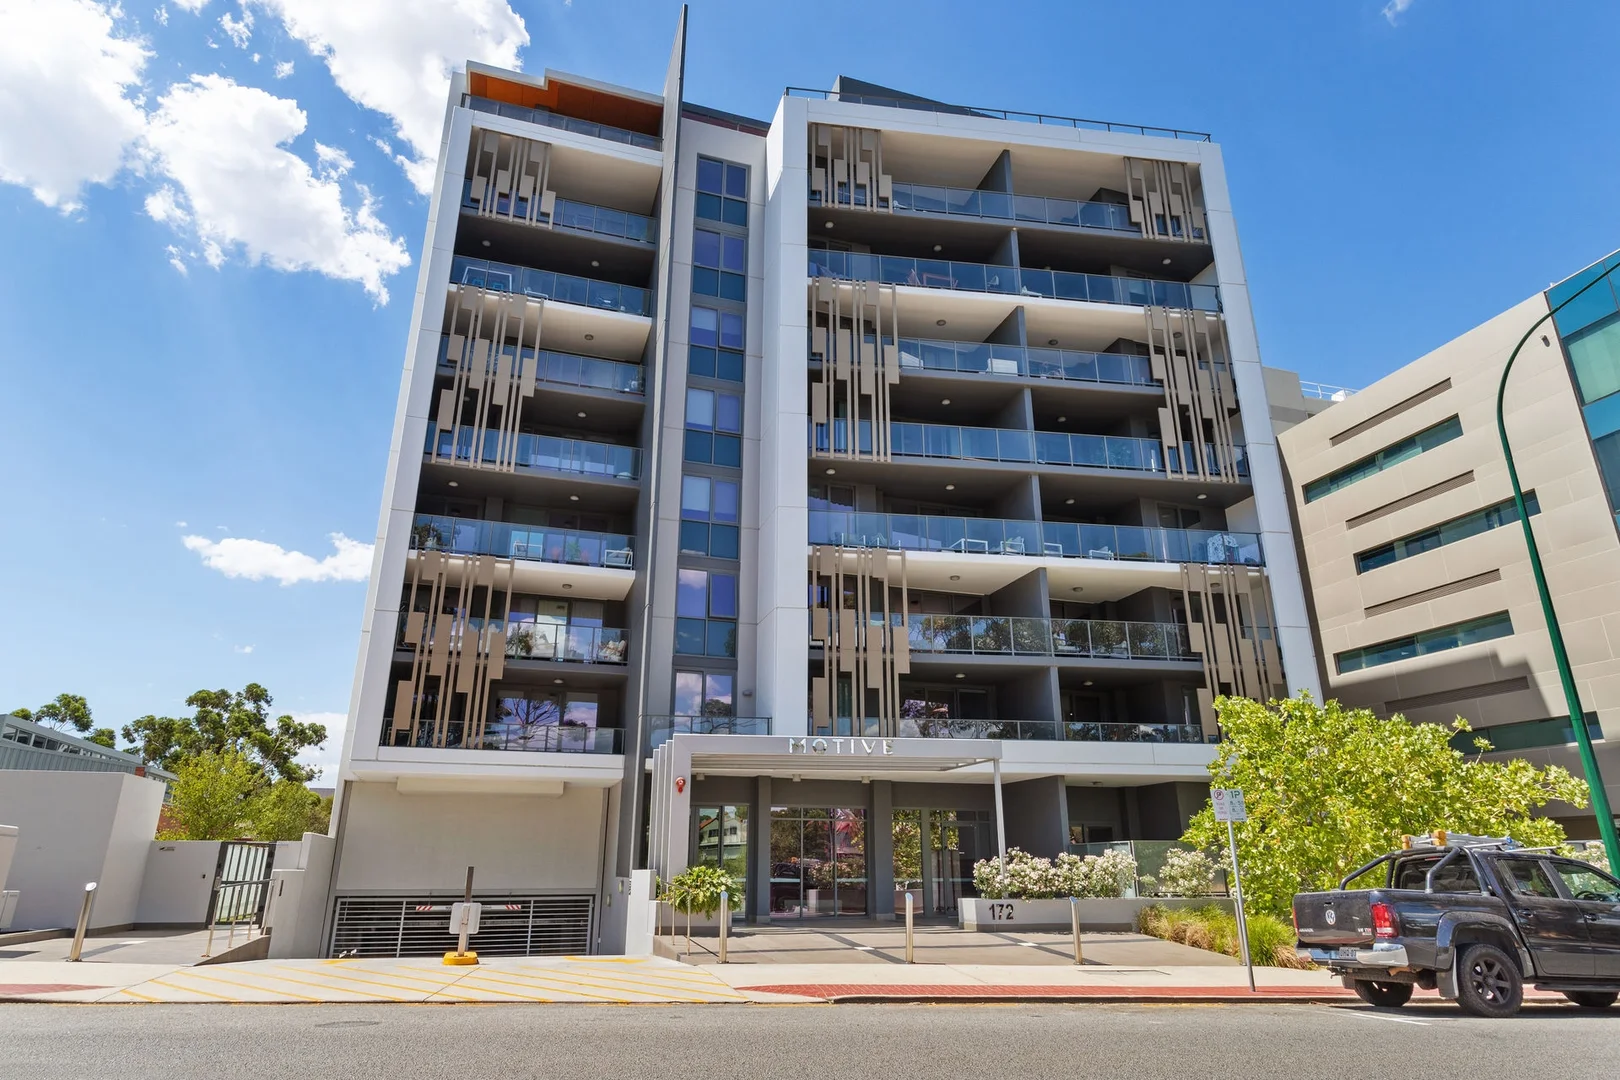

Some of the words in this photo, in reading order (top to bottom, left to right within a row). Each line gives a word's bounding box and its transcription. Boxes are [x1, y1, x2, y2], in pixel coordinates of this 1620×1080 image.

[789, 738, 894, 755] MOTIVE
[1230, 790, 1240, 799] 1P
[988, 903, 1014, 920] 172
